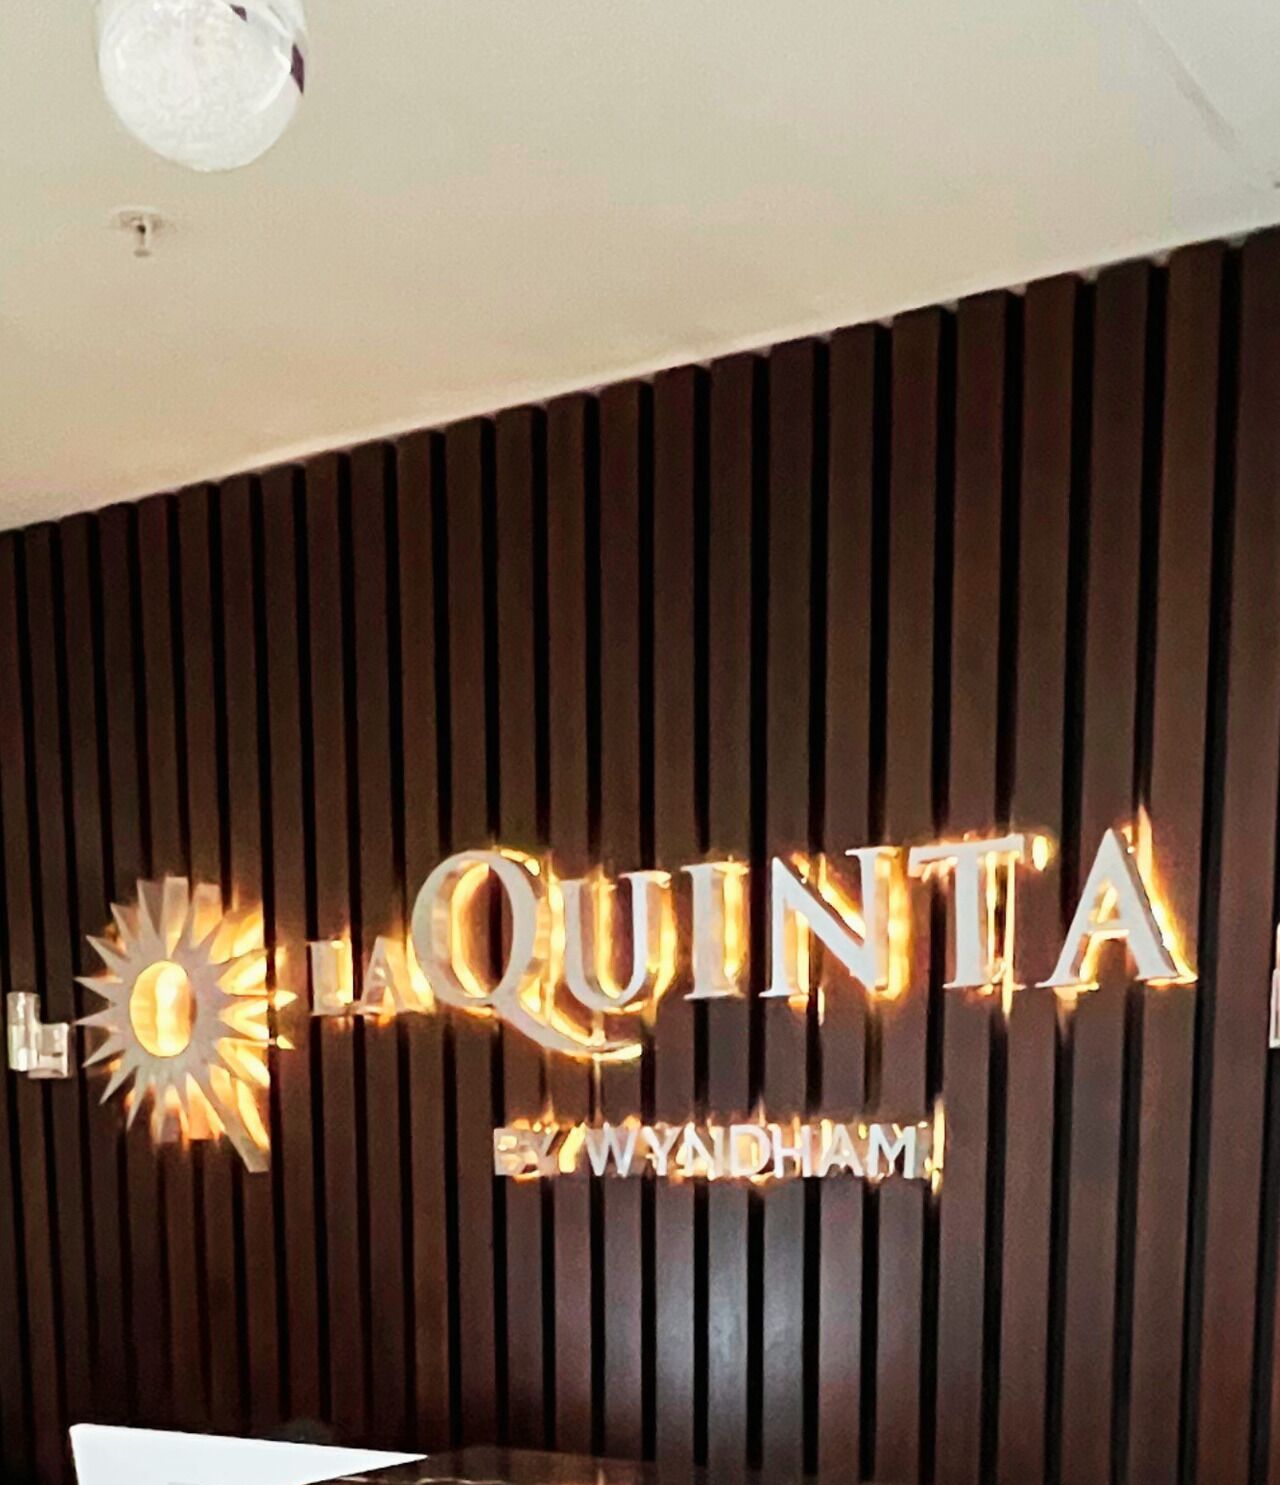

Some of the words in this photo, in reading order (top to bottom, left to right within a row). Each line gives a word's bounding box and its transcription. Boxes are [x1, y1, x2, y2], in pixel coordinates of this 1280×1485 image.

[307, 935, 432, 1016] LA
[410, 826, 1184, 1058] QUINTA
[493, 1124, 562, 1178] BY
[585, 1120, 918, 1180] WYNDHAM
